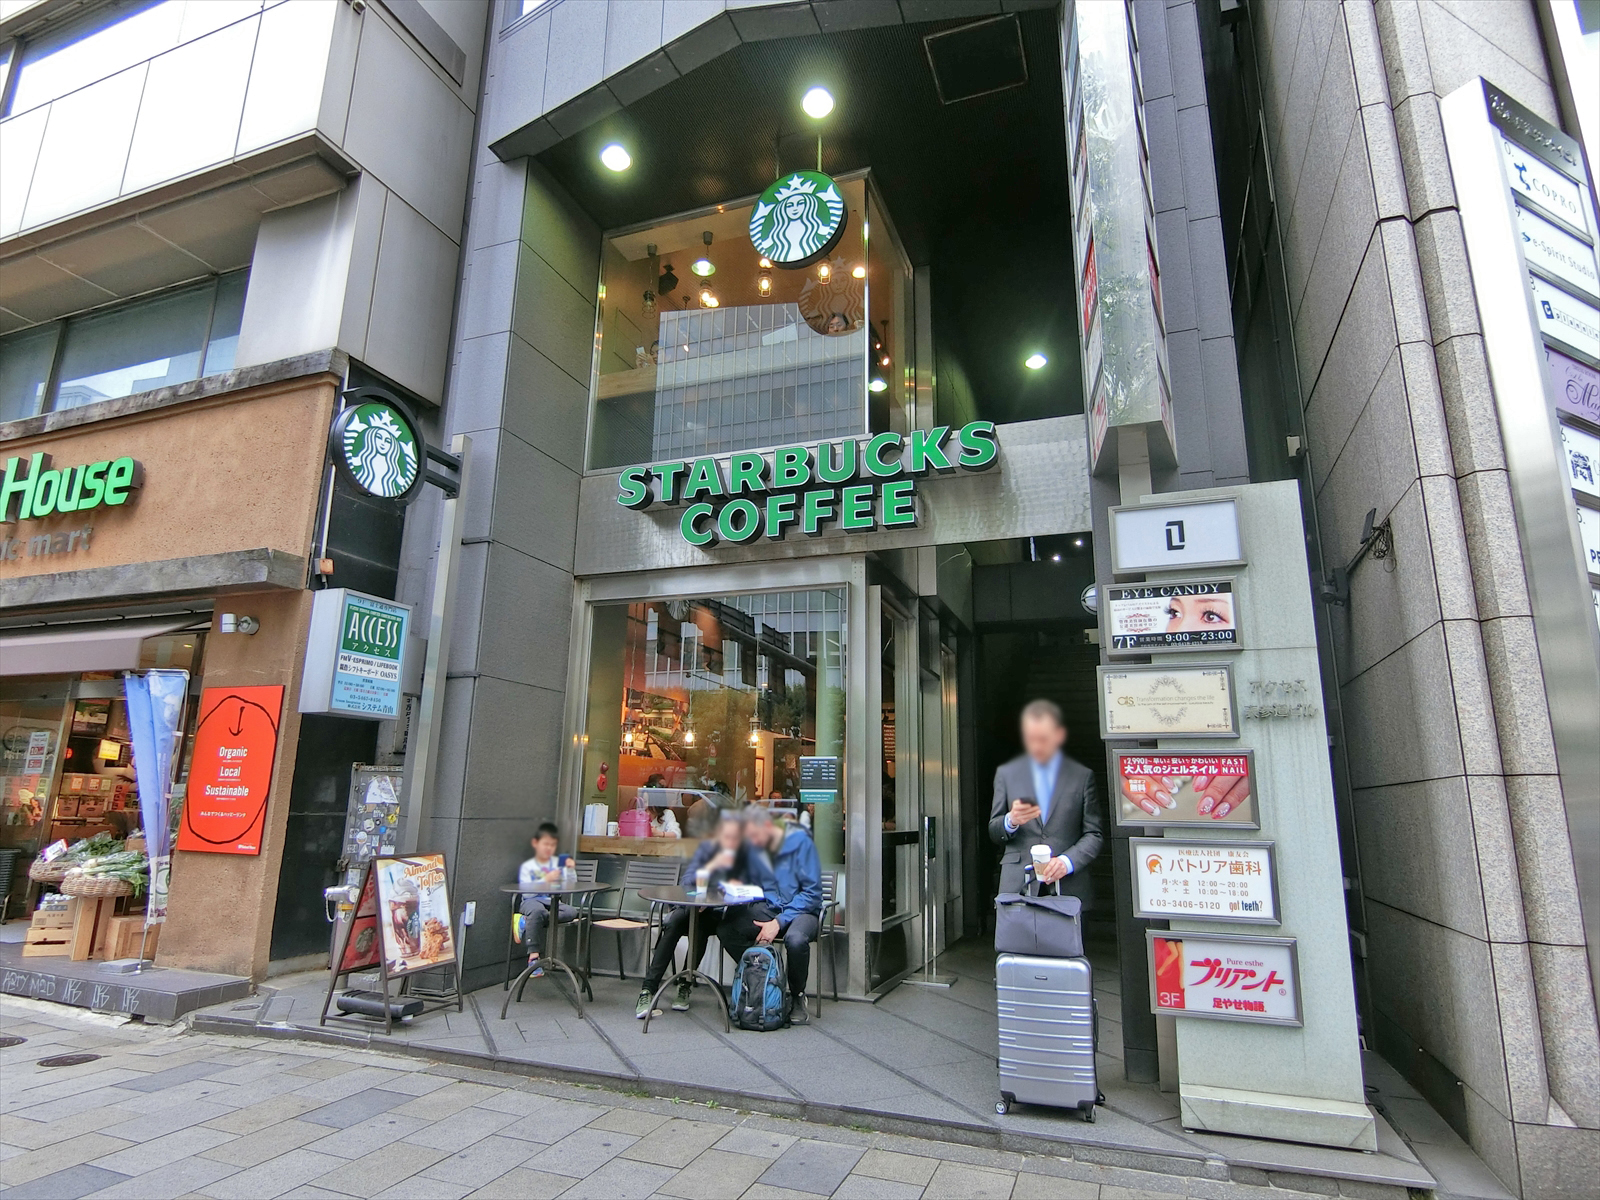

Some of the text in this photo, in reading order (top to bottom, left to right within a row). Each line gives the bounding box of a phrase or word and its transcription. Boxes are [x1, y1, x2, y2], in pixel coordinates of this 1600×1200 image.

[1532, 178, 1577, 214] COPRO
[1533, 238, 1596, 280] e-Spirit Studio
[617, 421, 997, 507] STARBUCKS
[0, 452, 135, 523] House
[680, 480, 916, 546] COFFEE
[0, 523, 93, 561] ic mart
[1121, 584, 1219, 599] EYE CANDY
[348, 612, 398, 648] ACCESS
[352, 642, 391, 657] アクセス
[1114, 635, 1137, 649] 7F
[376, 661, 398, 670] LIFEBOOK
[380, 671, 397, 679] OASYS
[219, 746, 248, 759] Organic
[220, 766, 241, 777] Local
[1124, 765, 1218, 775] 大人気のジェルネイル
[1222, 766, 1245, 774] NAIL
[205, 785, 249, 796] Sustainable
[404, 857, 438, 878] Almond
[1170, 859, 1261, 876] パトリア歯科
[417, 871, 444, 891] Toffee
[1156, 899, 1263, 912] 03-3406-5120 got teeth?
[1160, 992, 1180, 1006] 3F
[1213, 998, 1265, 1012] 足やせ物語
